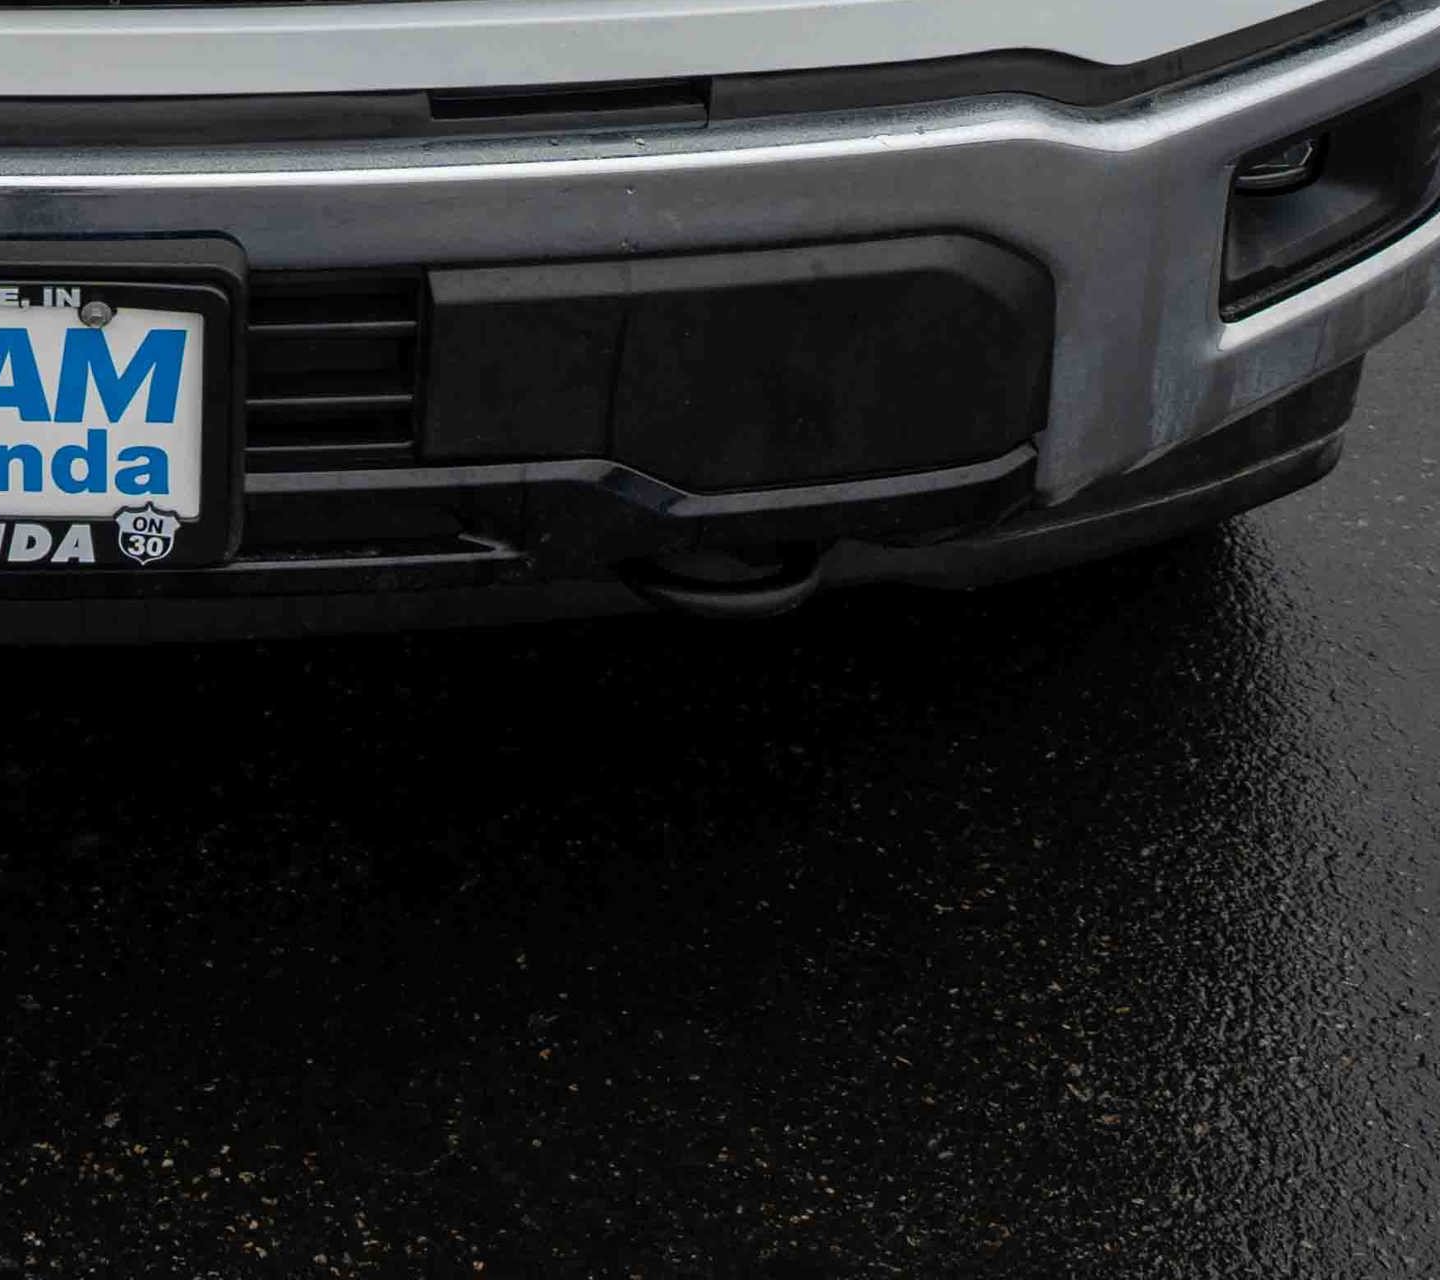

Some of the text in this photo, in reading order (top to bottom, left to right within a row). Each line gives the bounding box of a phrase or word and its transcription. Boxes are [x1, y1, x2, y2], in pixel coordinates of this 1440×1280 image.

[42, 287, 81, 309] IN
[132, 516, 164, 535] ON
[127, 534, 164, 557] 30
